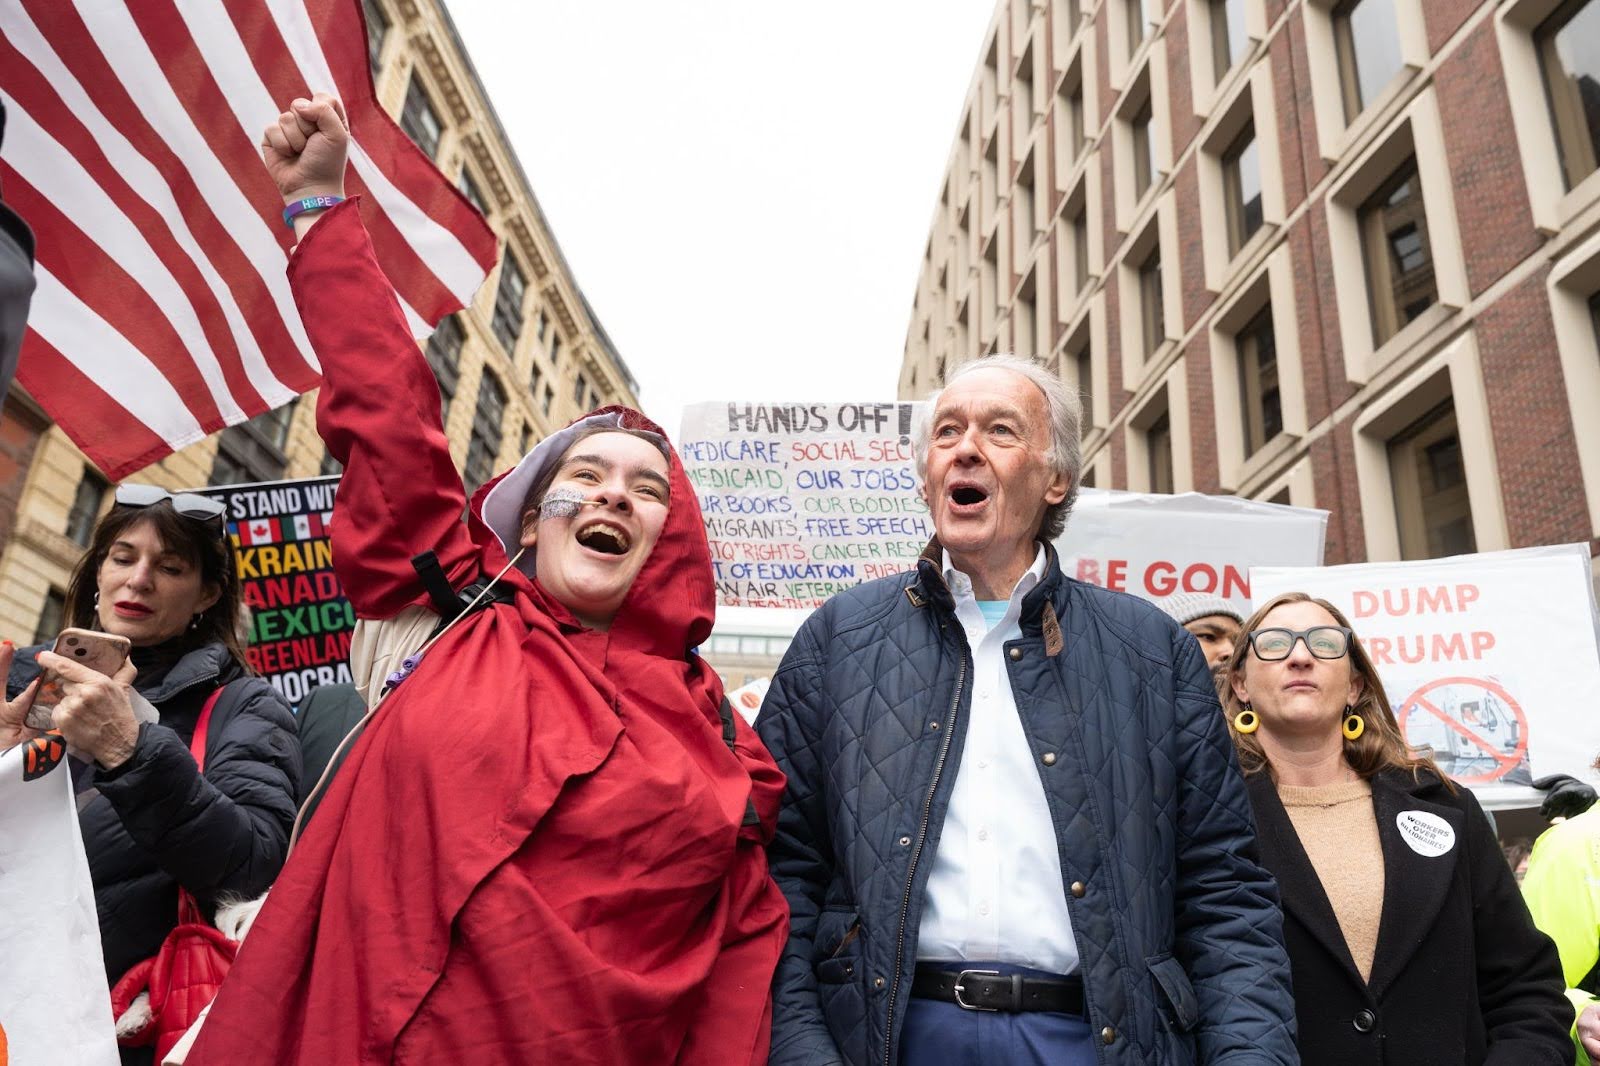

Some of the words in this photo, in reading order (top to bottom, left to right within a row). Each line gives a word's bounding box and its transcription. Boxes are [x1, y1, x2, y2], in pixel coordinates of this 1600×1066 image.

[728, 402, 828, 434] HANDS
[838, 402, 913, 446] OFF!
[683, 440, 788, 469] MEDICARE,
[792, 440, 864, 461] SOCIAL
[685, 467, 789, 494] MEDICAID,
[797, 470, 844, 490] OUR
[850, 467, 915, 491] JOBS
[231, 488, 302, 519] STAND
[725, 495, 797, 519] BOOKS,
[804, 497, 846, 514] OUR
[849, 496, 929, 514] BODIES
[805, 518, 852, 537] FREE
[857, 517, 933, 539] SPEECH,
[709, 540, 741, 561] TQ+
[742, 542, 809, 564] RIGHTS,
[812, 542, 882, 560] CANCER
[730, 563, 752, 579] OF
[1077, 558, 1127, 592] BE
[1143, 561, 1251, 600] GON
[244, 572, 346, 609] ANAD
[785, 582, 859, 600] VETERAN
[1352, 583, 1480, 618] DUMP
[248, 602, 355, 643] EXICO
[1407, 815, 1450, 838] WORKERS
[1413, 825, 1437, 840] OVER
